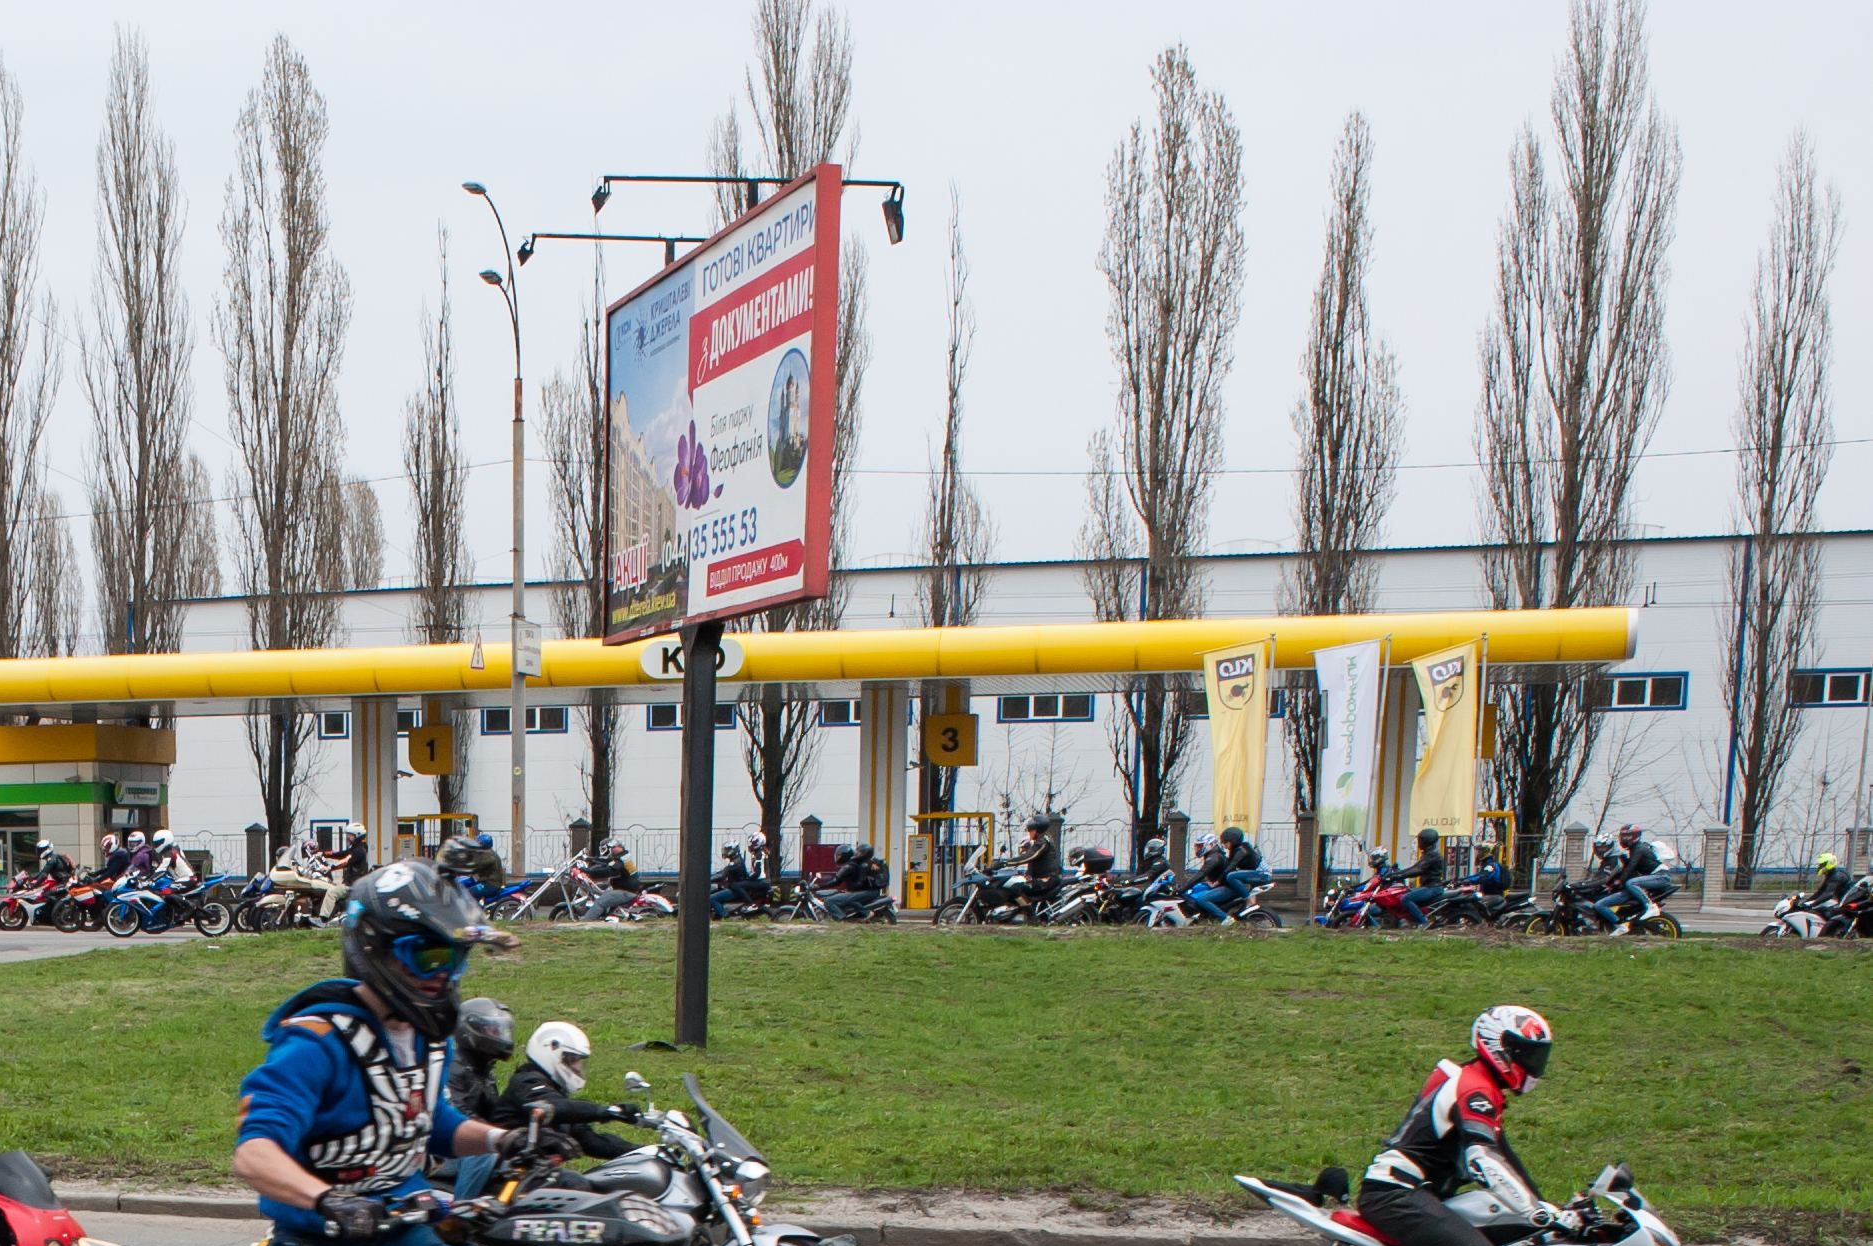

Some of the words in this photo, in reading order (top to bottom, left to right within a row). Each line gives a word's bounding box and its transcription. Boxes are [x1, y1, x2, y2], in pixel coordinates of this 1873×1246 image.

[702, 247, 744, 297] ГОТОВІ
[650, 309, 681, 346] ДЖЕРЕЛА
[709, 264, 814, 371] ДОКУМЕНТАМИ!
[710, 413, 727, 438] Біля
[728, 403, 754, 432] парку
[710, 427, 763, 475] Феофанія
[712, 514, 735, 556] 555
[740, 507, 757, 547] 53
[612, 533, 649, 595] АКЦІЇ
[732, 557, 768, 582] ПРОДАЖУ
[426, 740, 435, 762] 1
[941, 727, 959, 753] 3
